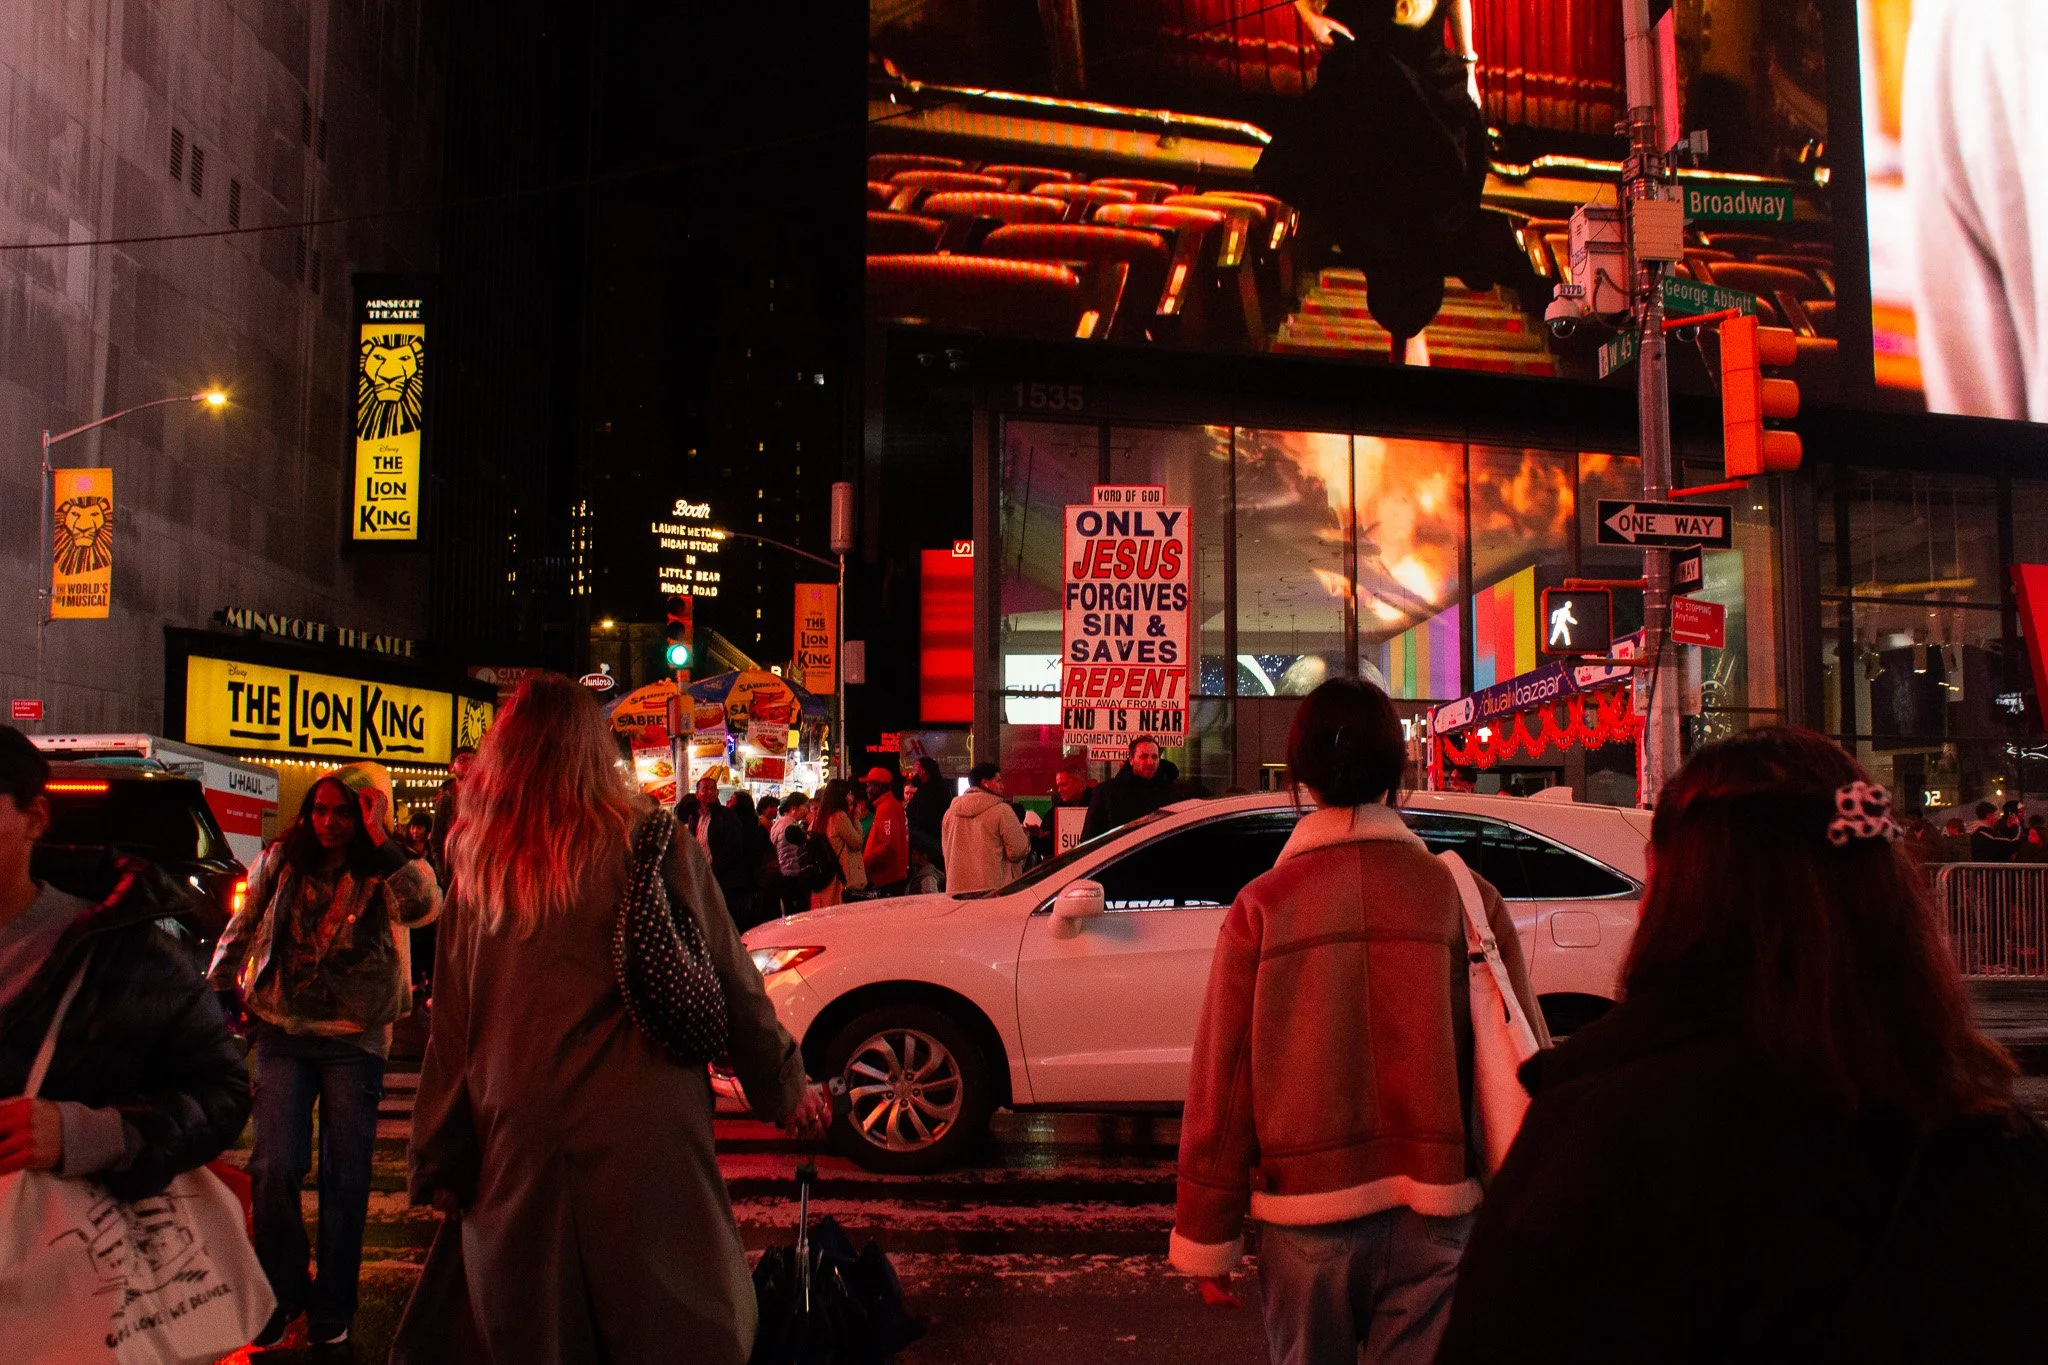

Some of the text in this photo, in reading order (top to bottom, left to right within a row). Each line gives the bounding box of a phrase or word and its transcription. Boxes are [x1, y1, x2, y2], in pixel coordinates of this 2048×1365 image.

[1690, 190, 1785, 221] Broadway
[1560, 285, 1582, 294] NYPD
[1665, 280, 1708, 304] George
[1713, 290, 1751, 313] Abbott
[365, 300, 423, 309] MINSKOFF
[367, 310, 421, 319] THEATRE
[1609, 342, 1618, 368] W
[1012, 381, 1084, 411] 1535
[373, 456, 403, 469] THE
[1097, 489, 1160, 502] WORD OF GOD
[672, 499, 711, 519] Booth
[651, 522, 686, 536] LAURIE
[1076, 510, 1182, 537] ONLY
[1618, 515, 1714, 535] ONE WAY
[660, 538, 719, 552] MICAH STOCK
[686, 554, 696, 565] IN
[1072, 539, 1183, 580] JESUS
[659, 567, 721, 582] LITTLE BEAR
[67, 583, 108, 594] WORLD'S
[661, 583, 718, 597] RIDGE ROAD
[66, 595, 107, 607] MUSICAL
[1066, 582, 1188, 611] FORGIVES
[1675, 601, 1712, 615] NO STOPPING
[805, 618, 826, 628] THE
[1674, 611, 1698, 623] Anytime
[224, 605, 416, 658] MINSKOFF THEATRE
[1082, 613, 1168, 637] SIN &
[1071, 639, 1178, 663] SAVES
[497, 668, 527, 679] CITY
[1065, 667, 1187, 699] REPENT
[227, 680, 281, 727] THE
[1065, 698, 1179, 709] TURN AWAY FROM SIN
[1064, 708, 1183, 732] END IS NEAR
[1065, 733, 1184, 747] JUDGMENT DAY OMING
[1091, 750, 1130, 760] MATTHE
